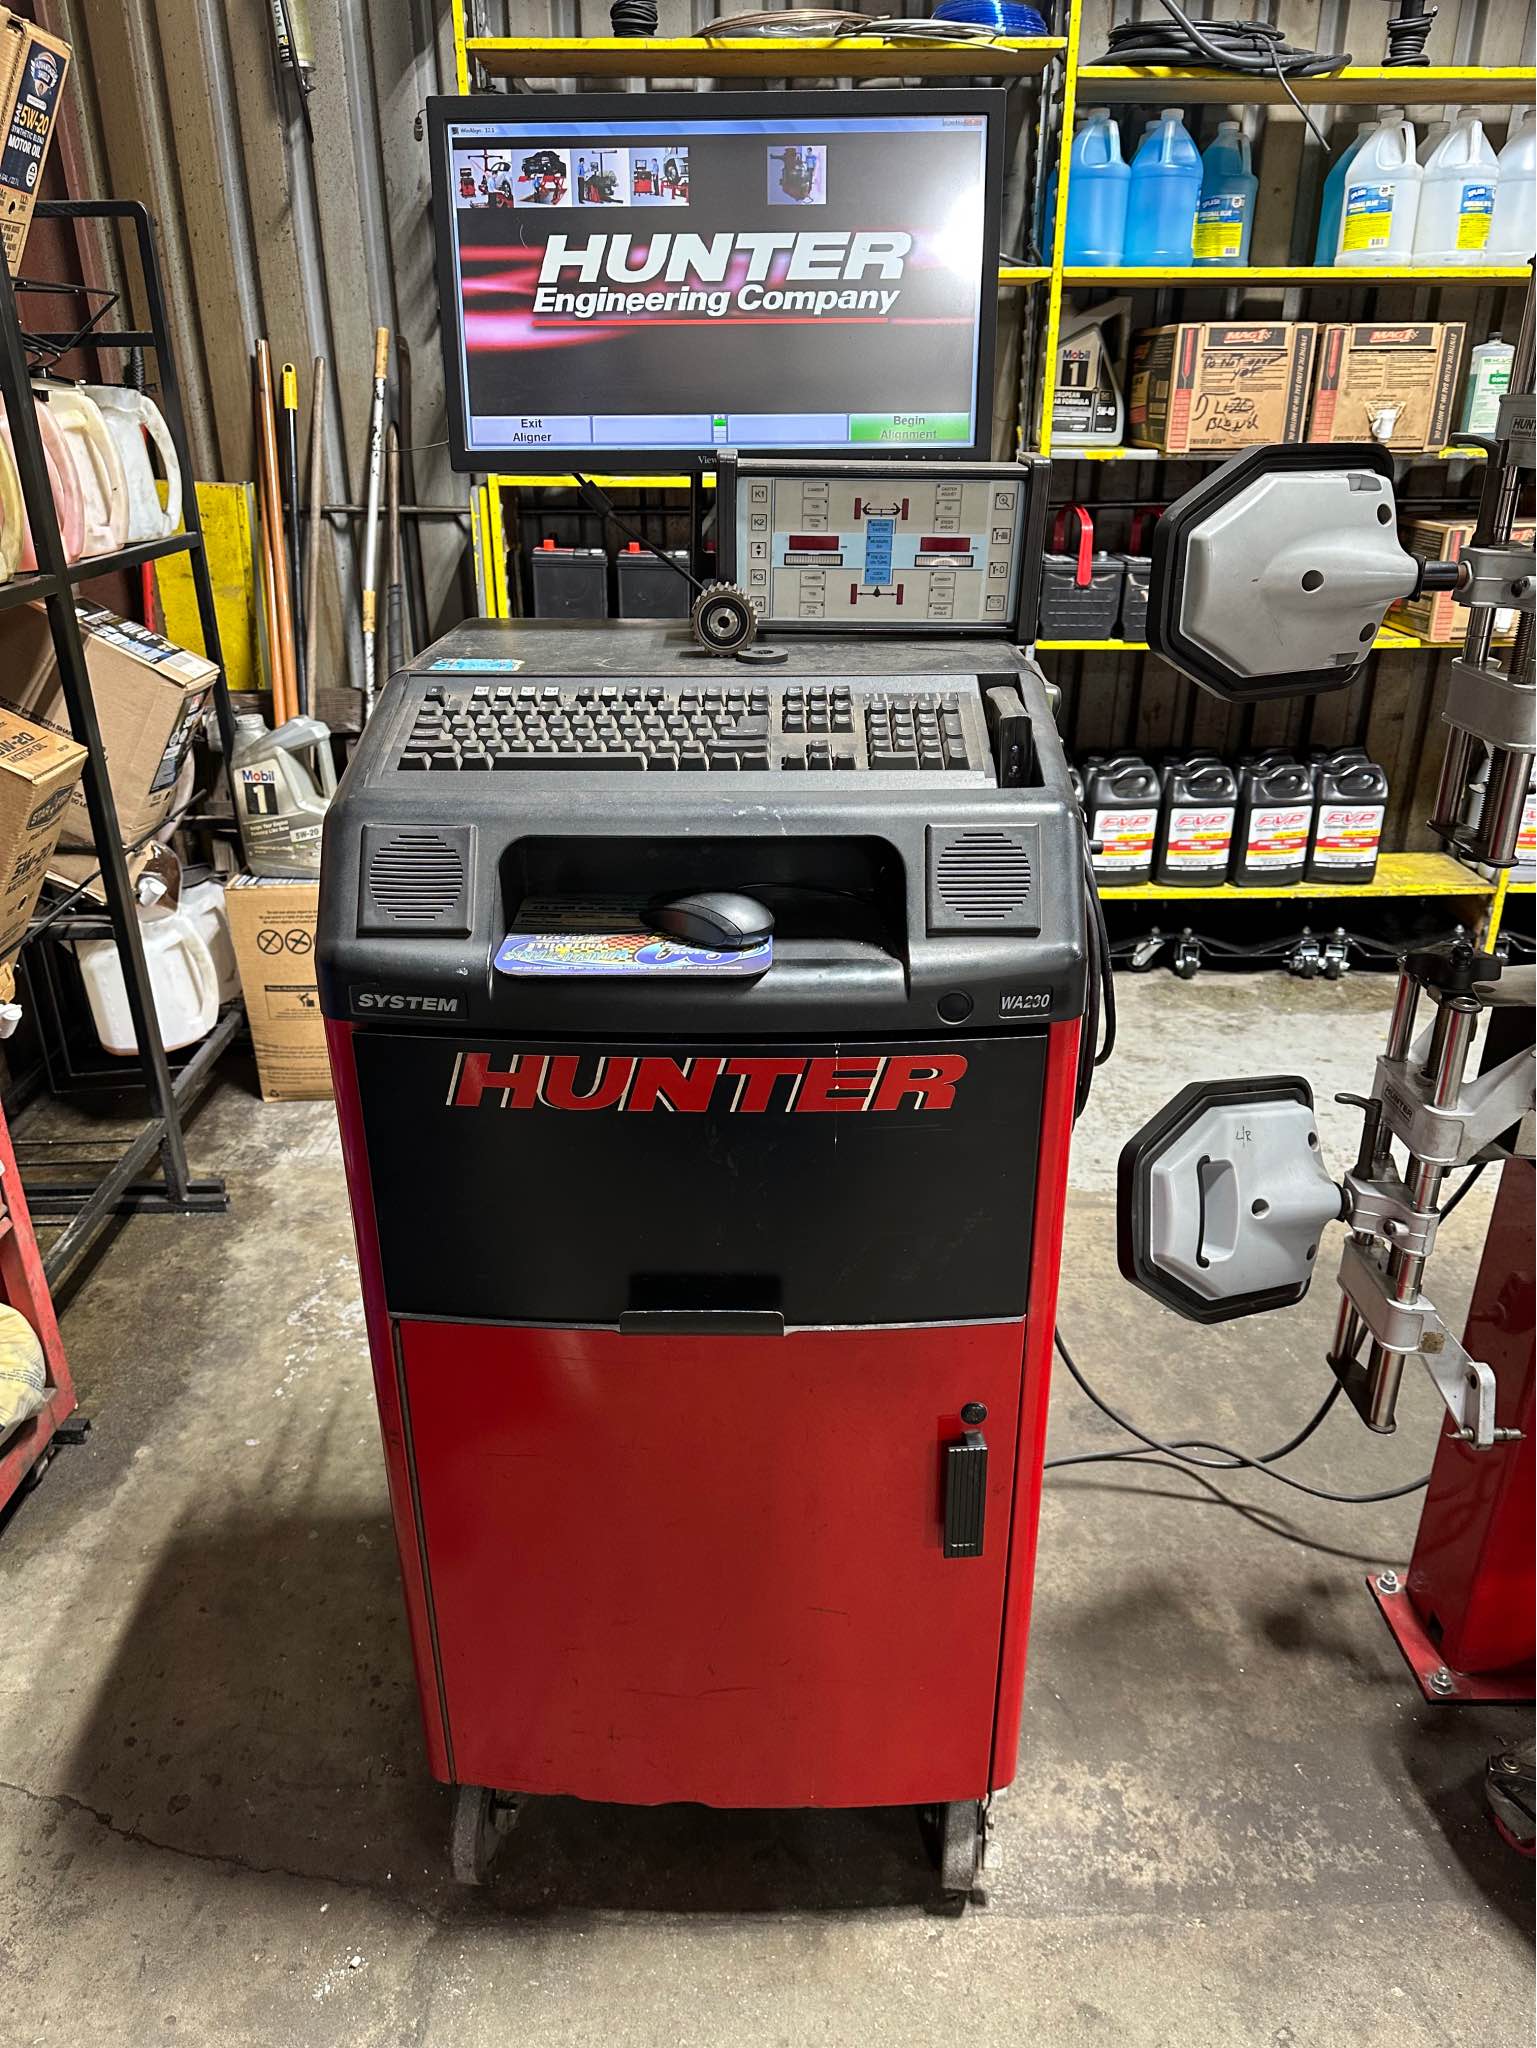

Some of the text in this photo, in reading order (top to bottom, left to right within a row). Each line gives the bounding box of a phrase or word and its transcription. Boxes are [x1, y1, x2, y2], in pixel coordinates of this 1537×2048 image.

[20, 105, 50, 136] 5W-20
[8, 134, 41, 159] MOTOR OIL
[538, 232, 912, 283] HUNTER
[533, 285, 900, 318] Engineering Company
[1062, 350, 1091, 359] Mobil
[1069, 362, 1080, 385] 1
[521, 419, 543, 428] Exit
[893, 416, 926, 427] Begin
[513, 432, 551, 443] Aligner
[880, 430, 937, 441] Alignment
[242, 770, 275, 781] Mobil
[252, 784, 268, 814] 1
[295, 828, 319, 840] 5W-20
[358, 993, 458, 1012] SYSTEM
[445, 1052, 968, 1113] HUNTER
